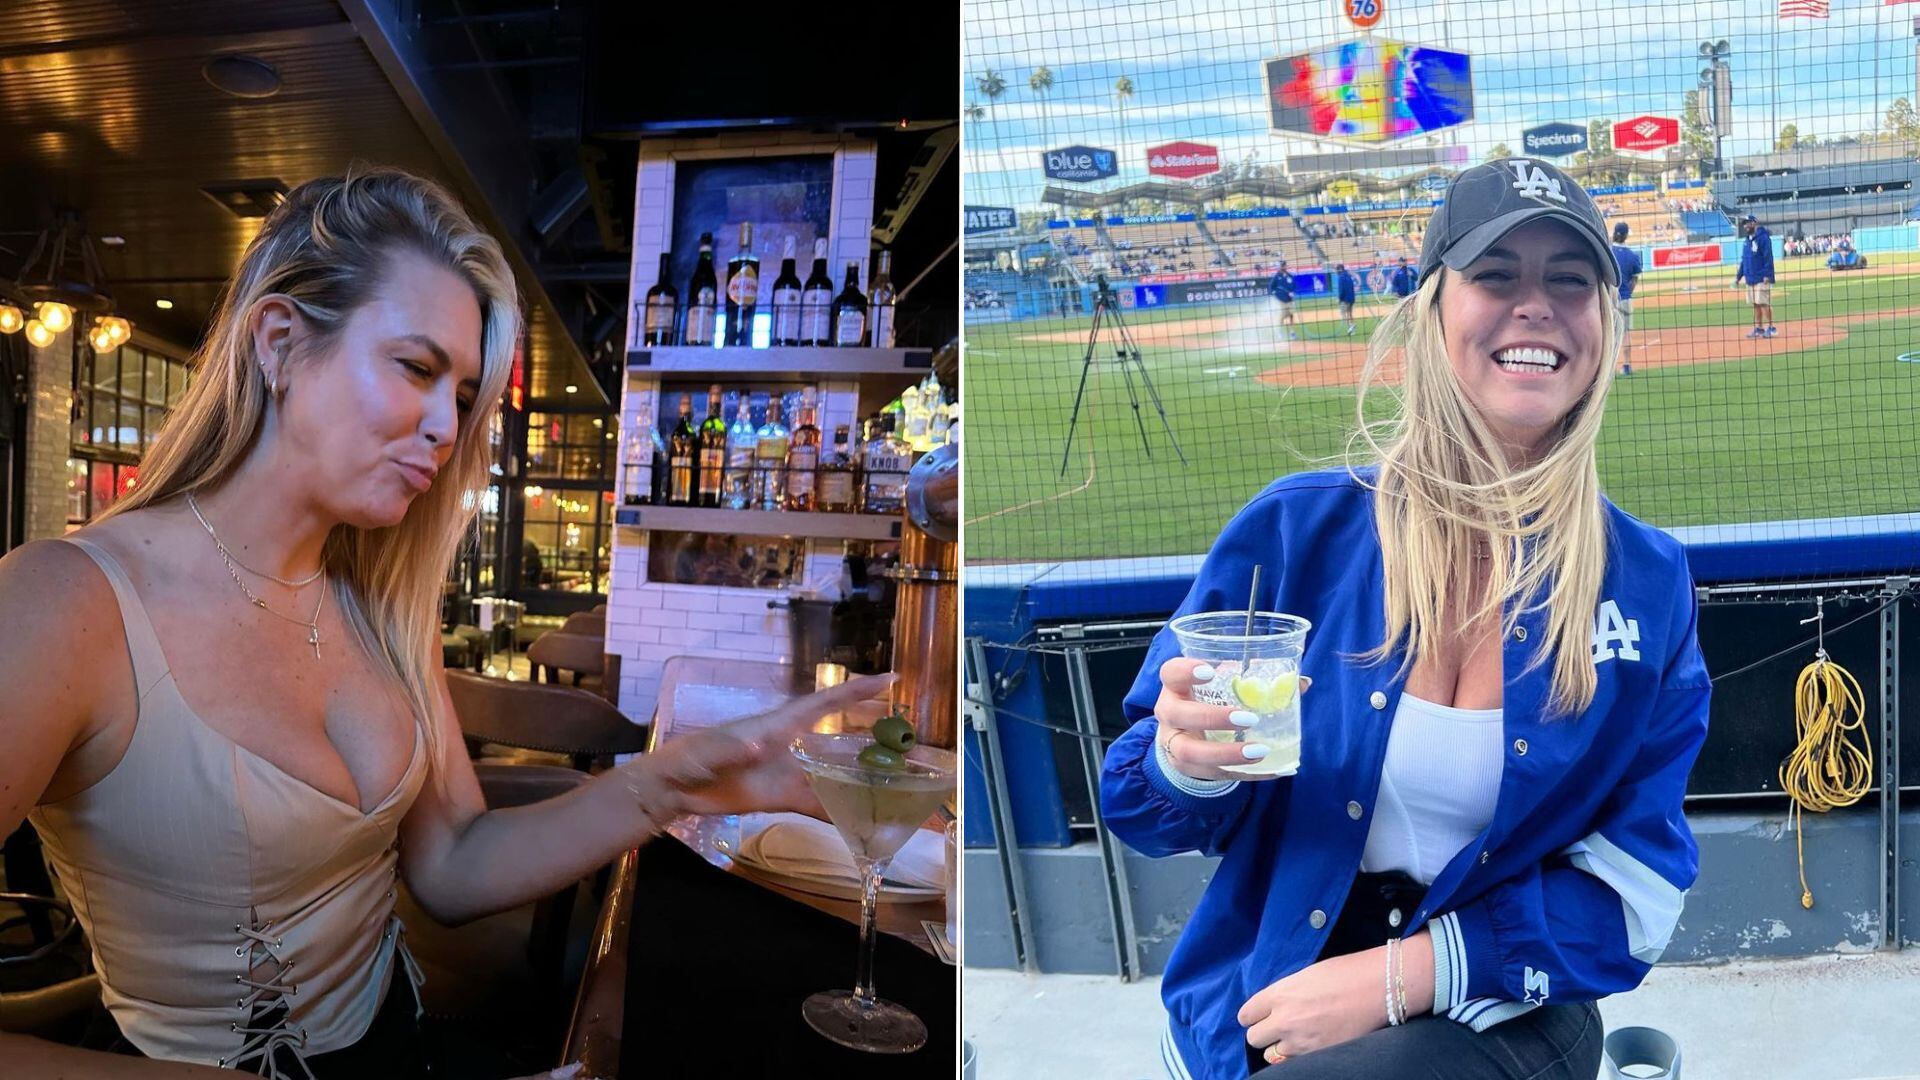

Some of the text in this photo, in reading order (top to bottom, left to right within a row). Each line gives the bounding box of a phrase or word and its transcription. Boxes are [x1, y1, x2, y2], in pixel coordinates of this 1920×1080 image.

[1351, 0, 1377, 18] 76
[1526, 132, 1581, 149] Spectrum
[1047, 151, 1092, 170] blue
[1509, 160, 1567, 203] LA
[964, 210, 1013, 229] ATER
[871, 456, 899, 469] KNOB
[1591, 599, 1641, 665] A
